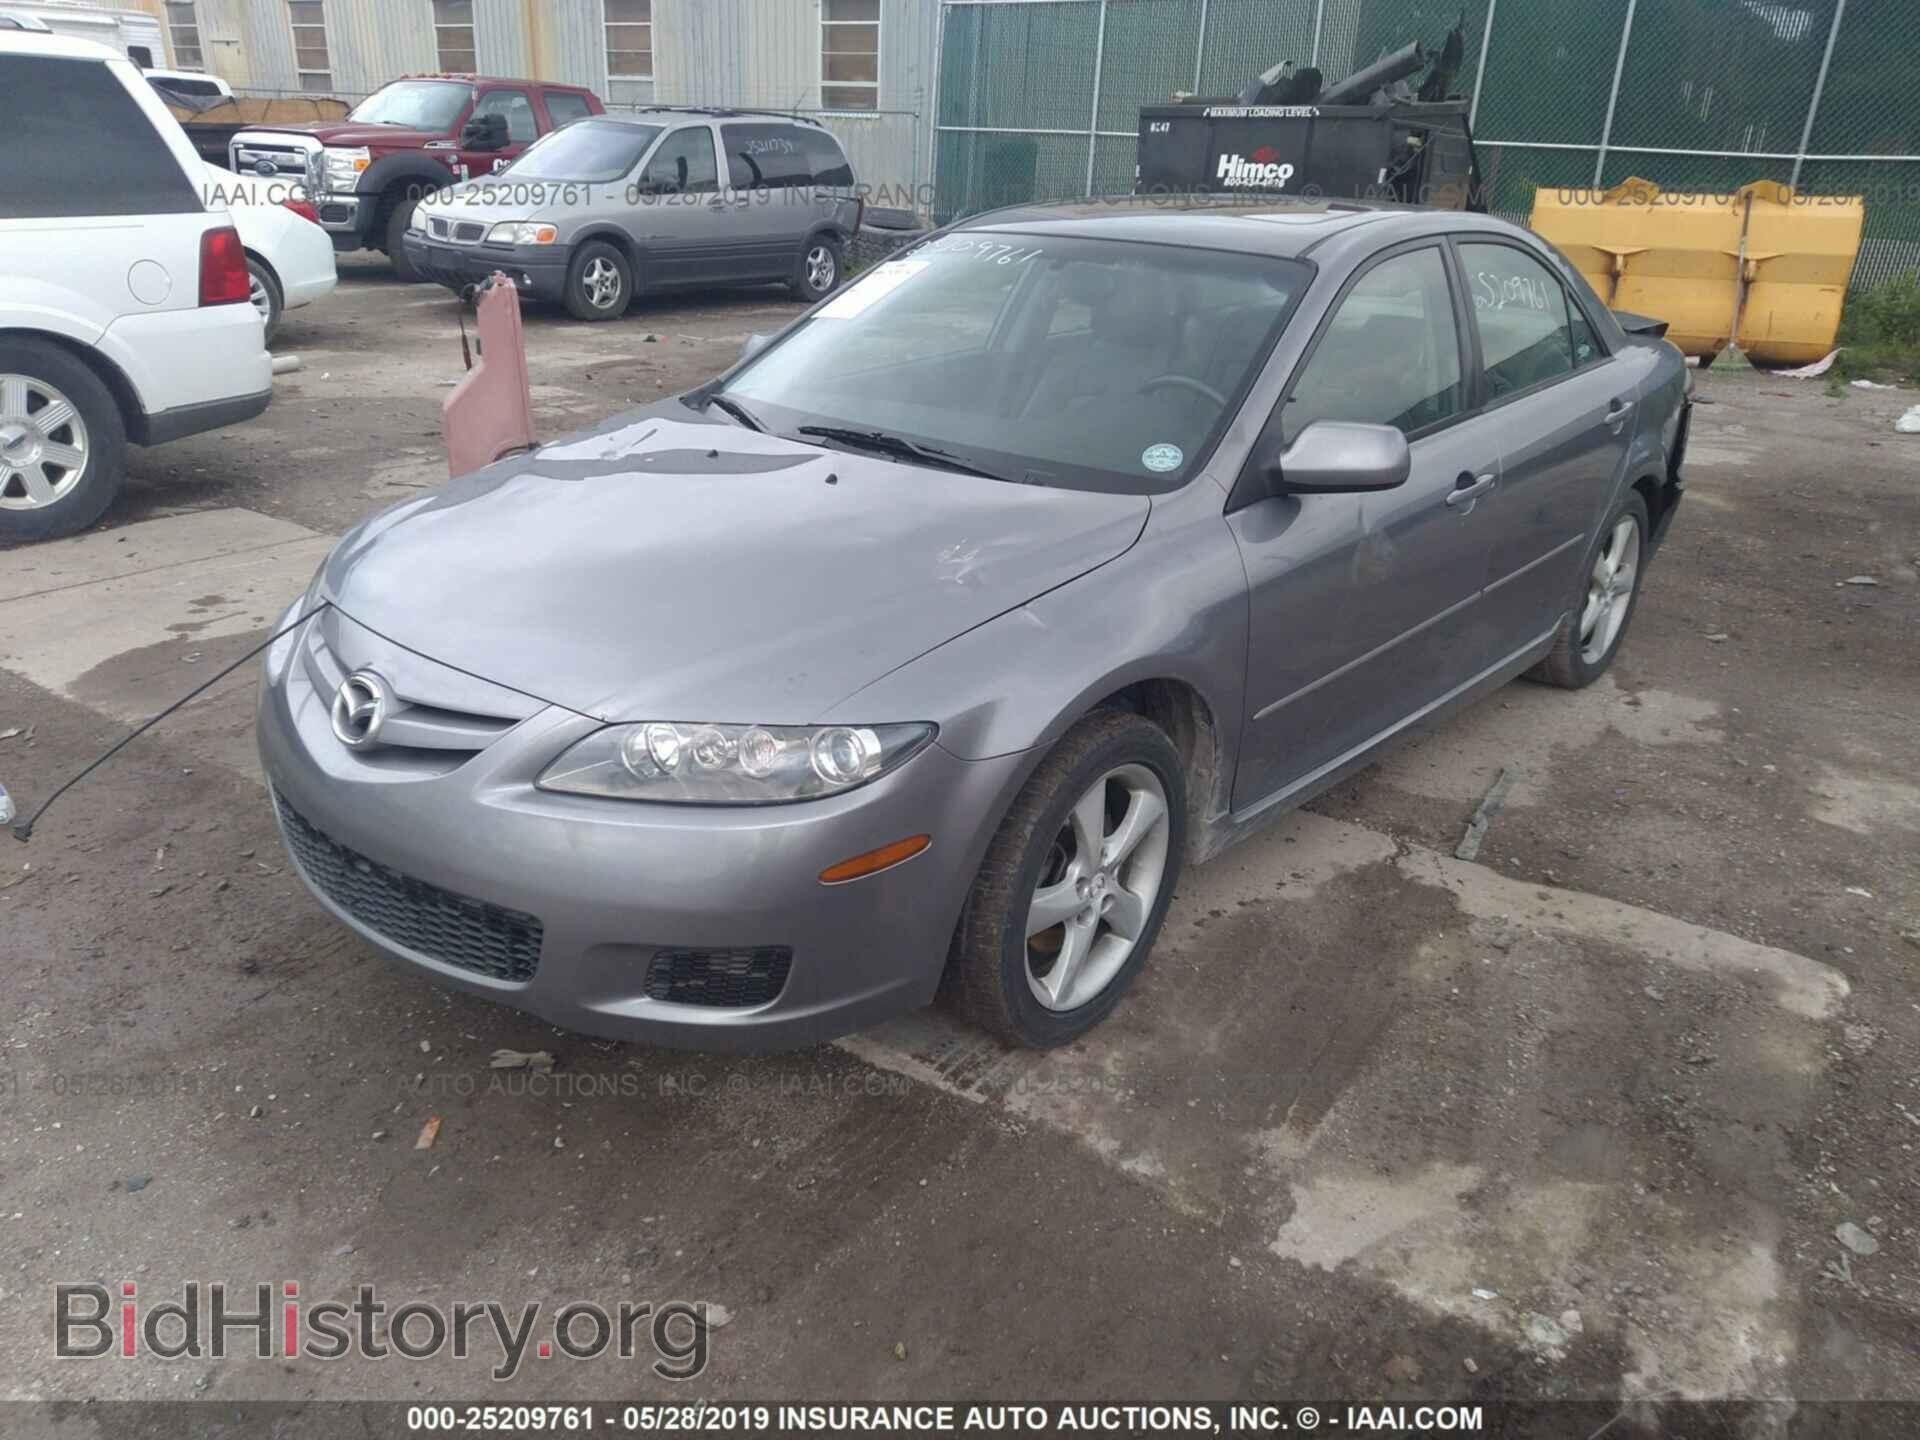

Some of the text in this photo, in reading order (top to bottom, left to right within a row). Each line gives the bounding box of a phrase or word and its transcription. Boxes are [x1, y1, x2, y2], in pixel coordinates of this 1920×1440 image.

[1249, 106, 1285, 117] LOADING
[1286, 105, 1313, 117] LEVEL
[1216, 154, 1294, 178] Himco
